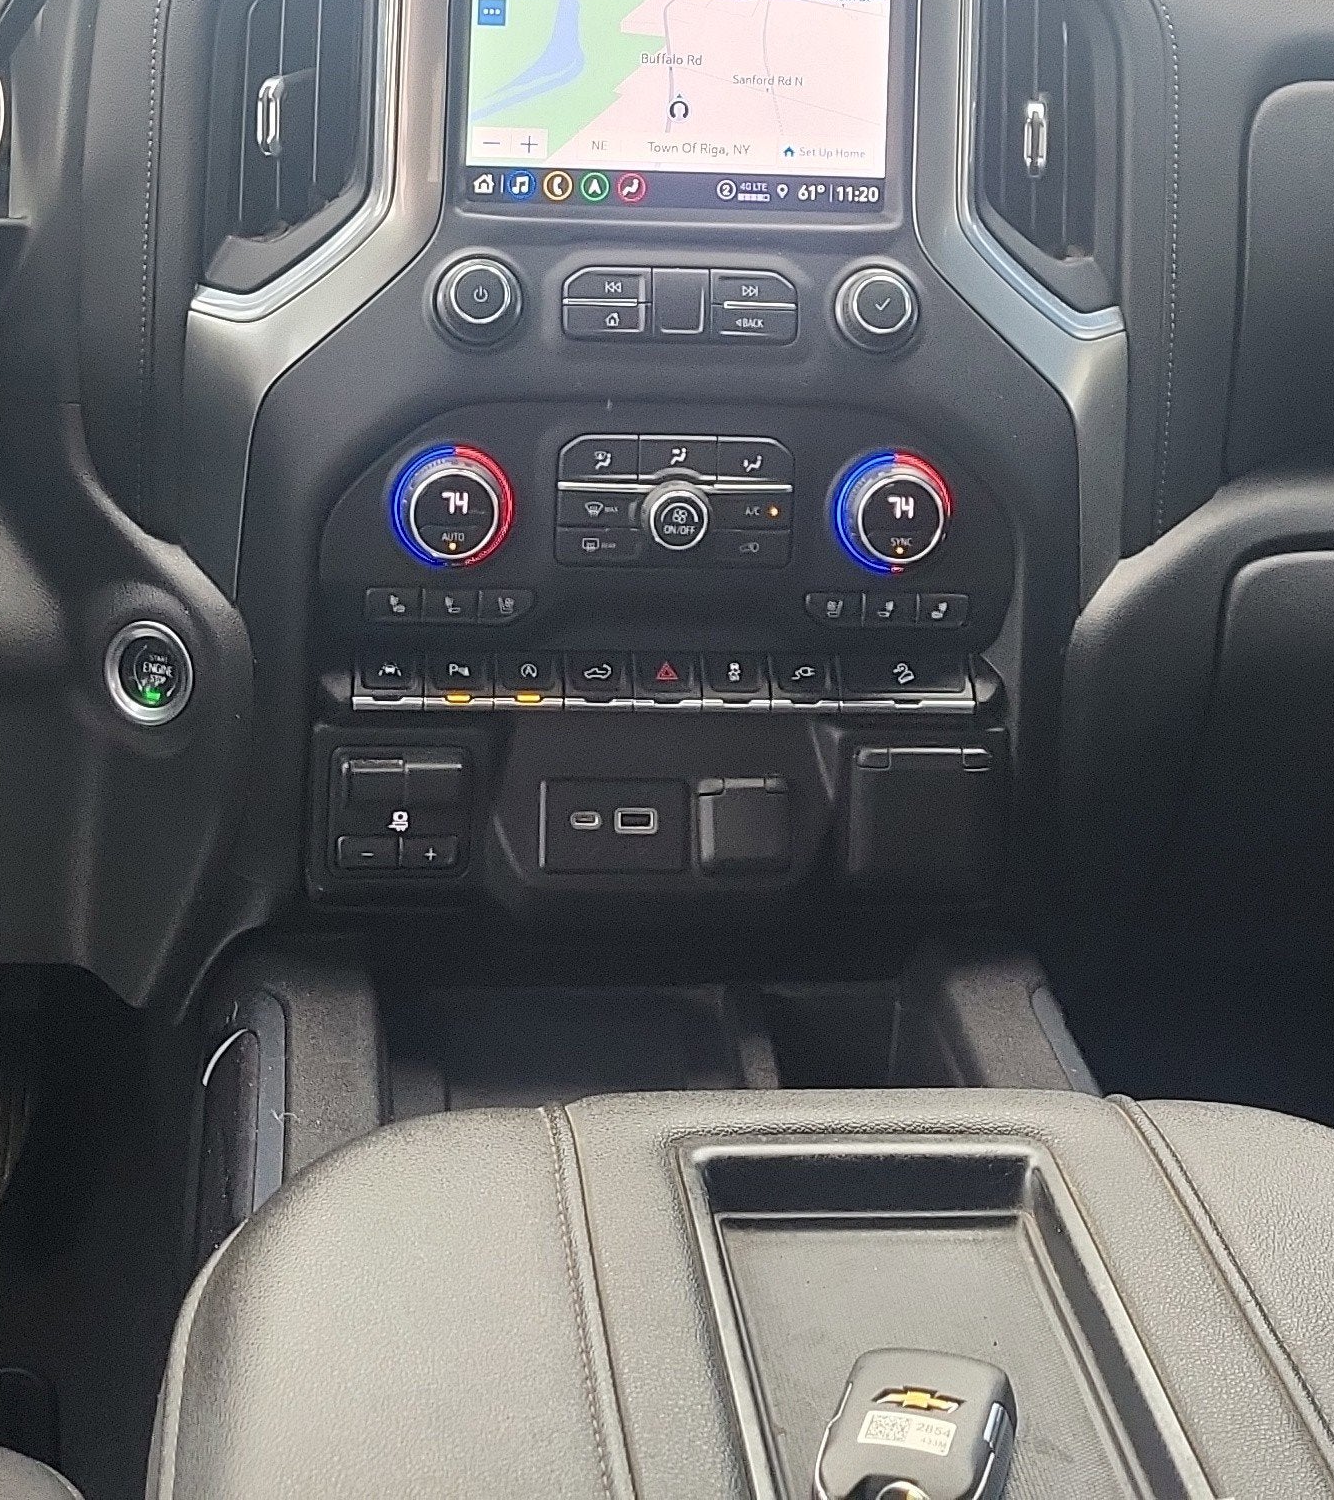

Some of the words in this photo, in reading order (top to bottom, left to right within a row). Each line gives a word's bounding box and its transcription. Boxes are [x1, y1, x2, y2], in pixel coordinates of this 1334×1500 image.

[641, 53, 683, 66] Buffalo
[687, 54, 703, 66] Rd
[732, 75, 774, 86] Sanford
[778, 76, 792, 86] Rd
[794, 77, 803, 86] N
[591, 141, 608, 151] NE
[648, 142, 679, 154] Town
[682, 143, 696, 154] Of
[700, 143, 729, 157] Riga,
[733, 144, 751, 155] NY
[799, 147, 815, 157] Set
[818, 148, 833, 159] Up
[836, 149, 866, 159] Home
[753, 183, 768, 191] LTE
[798, 184, 826, 201] 61°
[836, 186, 880, 202] 11:20
[742, 317, 764, 329] BACK
[441, 491, 468, 515] 74
[887, 496, 914, 519] 74
[745, 506, 760, 516] A/C
[663, 525, 697, 535] ON/OFF
[442, 532, 465, 542] AUTO
[890, 538, 913, 547] SYNC
[142, 661, 174, 677] ENGINE
